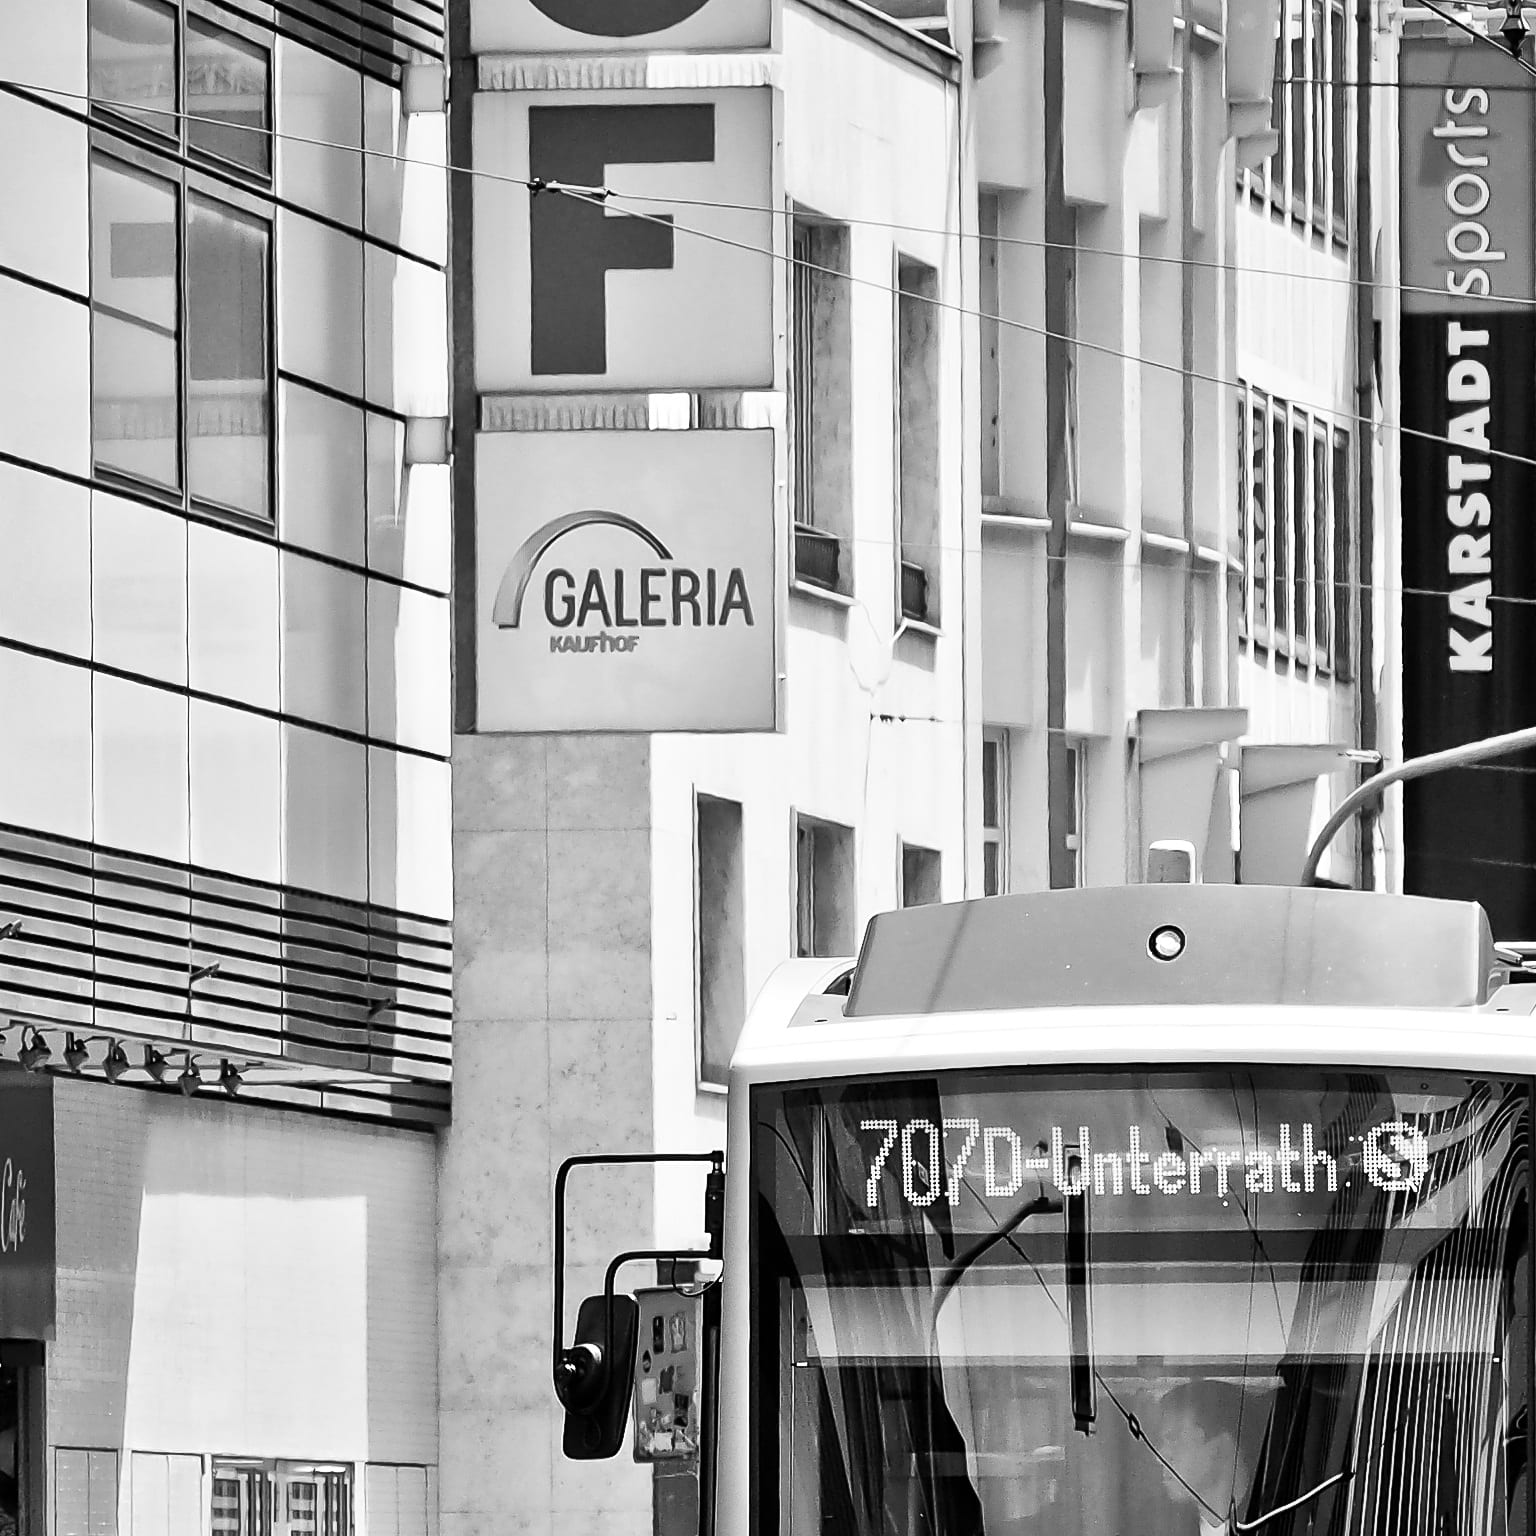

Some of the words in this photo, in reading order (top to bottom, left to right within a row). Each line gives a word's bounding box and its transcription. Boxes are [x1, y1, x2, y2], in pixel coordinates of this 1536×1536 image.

[529, 103, 715, 375] F
[1433, 86, 1506, 296] sports
[544, 567, 754, 628] GALERIA
[1447, 321, 1493, 673] KARSTADT
[860, 1118, 979, 1206] 707
[983, 1122, 1337, 1198] D-Unterrath
